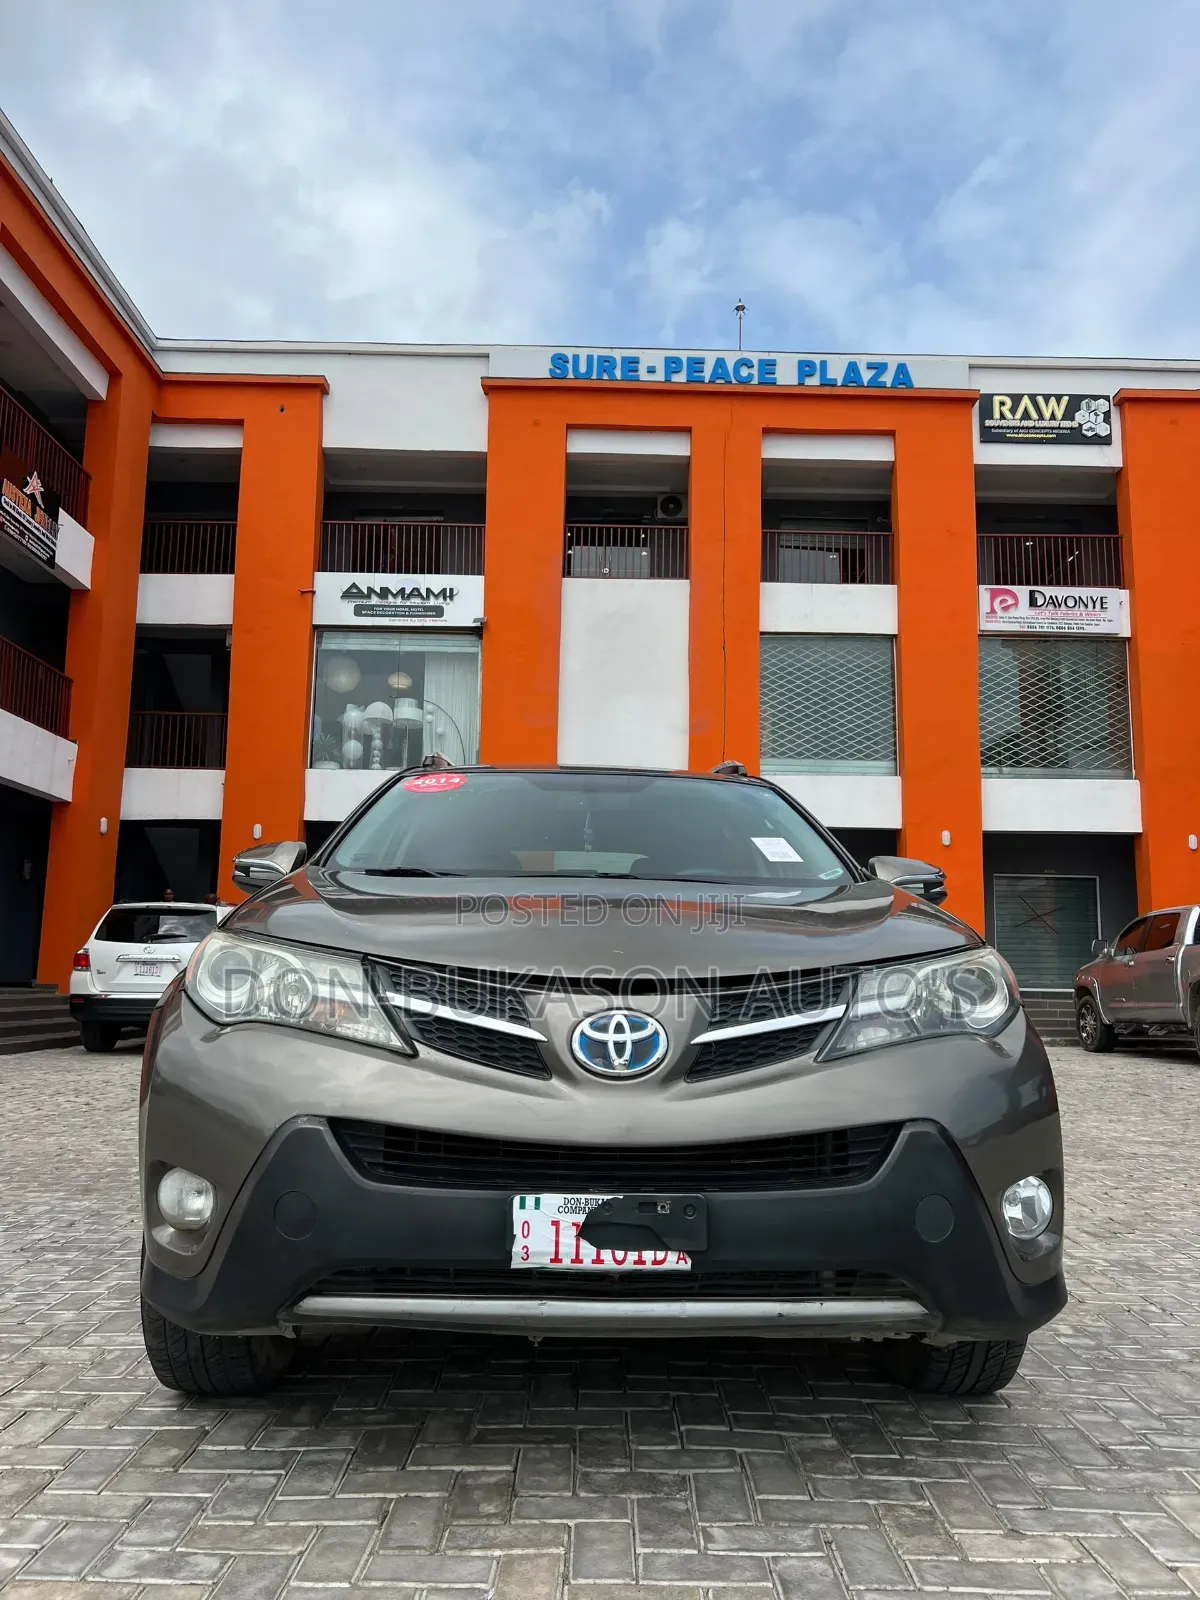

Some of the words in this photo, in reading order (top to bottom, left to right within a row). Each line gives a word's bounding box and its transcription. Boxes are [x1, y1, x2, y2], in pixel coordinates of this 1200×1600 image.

[797, 359, 914, 388] PLAZA
[993, 394, 1069, 420] RAW
[984, 419, 1020, 428] SOUVENIRS
[1020, 420, 1035, 428] AND
[1035, 420, 1060, 429] LUXURY
[1060, 420, 1079, 429] ITEMS
[340, 581, 456, 602] ANMAMI
[412, 777, 460, 785] 2014
